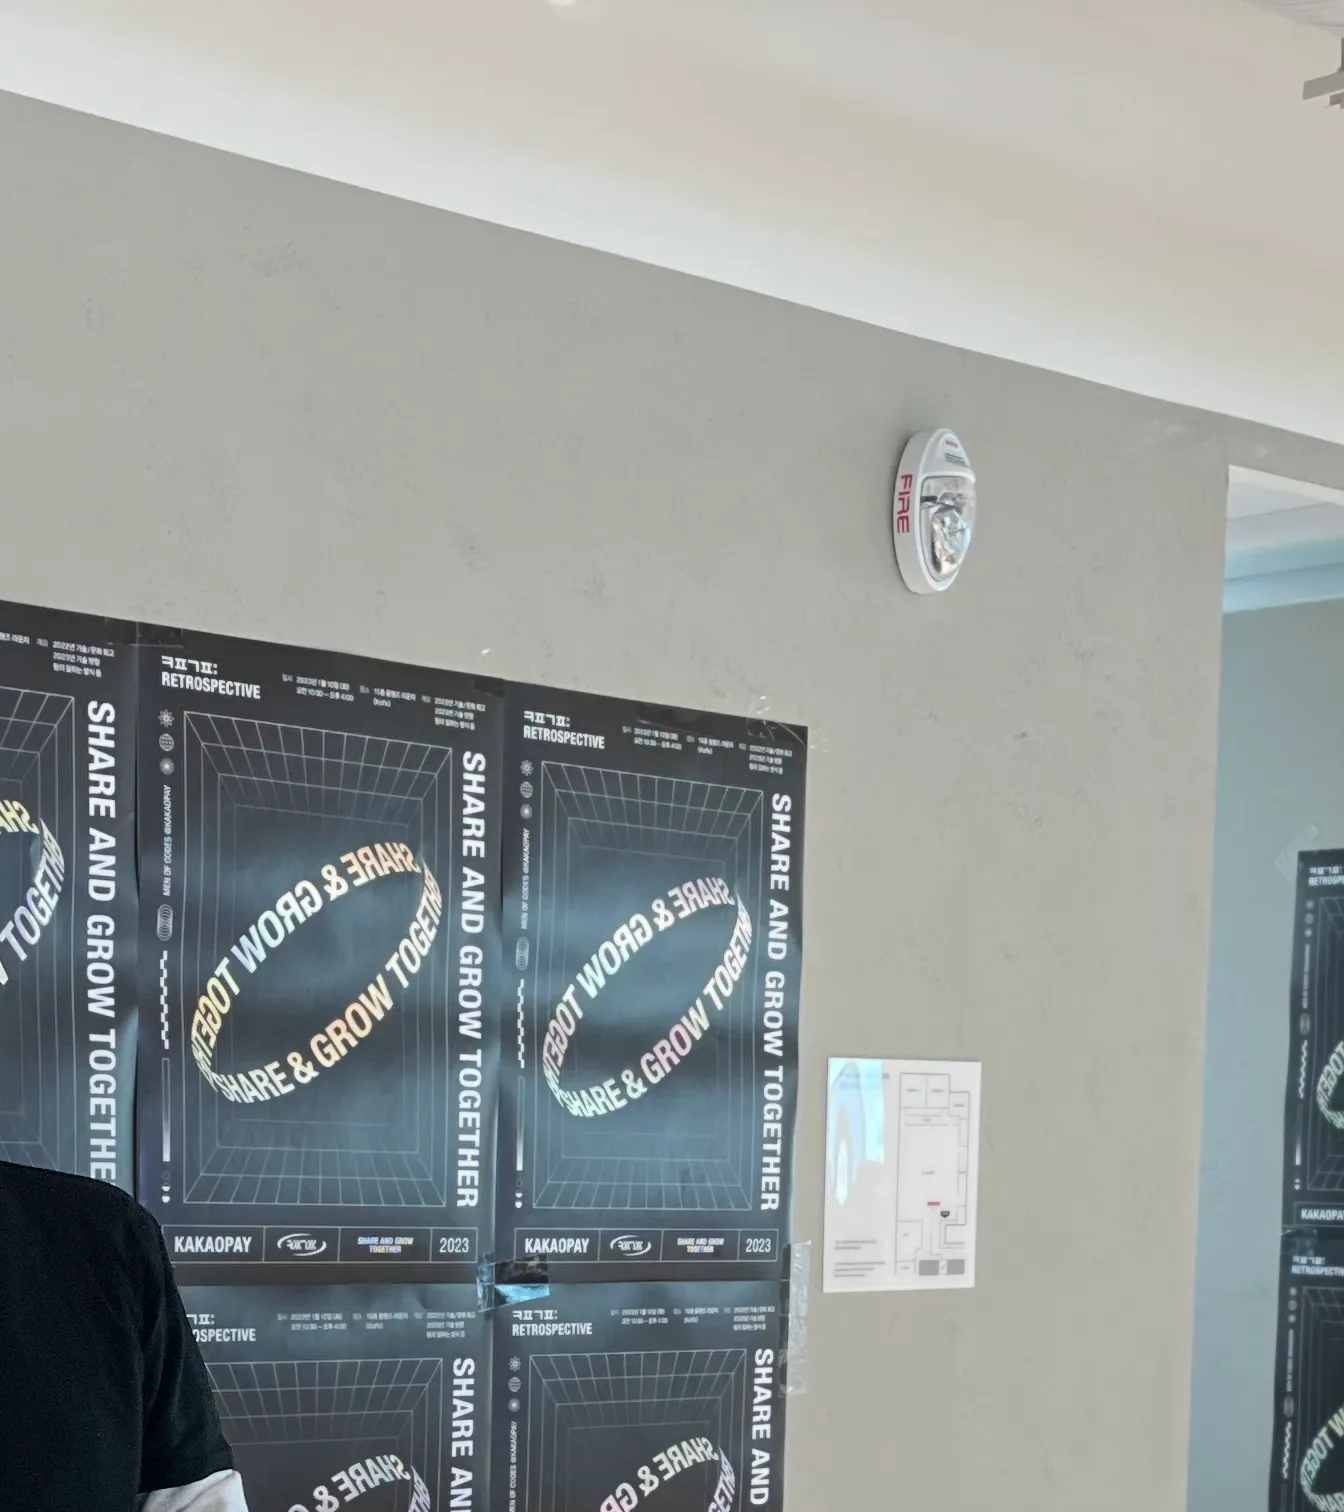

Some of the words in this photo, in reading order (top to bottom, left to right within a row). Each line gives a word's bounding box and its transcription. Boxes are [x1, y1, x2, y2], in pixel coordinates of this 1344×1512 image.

[897, 474, 913, 534] FIRE
[162, 670, 260, 699] RETROSPECTIVE
[87, 700, 116, 818] SHARE
[524, 724, 604, 749] RETROSPECTIVE
[462, 750, 485, 858] SHARE
[770, 793, 791, 891] SHARE
[88, 827, 116, 902] AND
[461, 866, 485, 934] AND
[87, 913, 114, 1017] GROW
[767, 899, 788, 961] AND
[458, 944, 482, 1038] GROW
[763, 970, 784, 1056] GROW
[211, 1061, 295, 1102] SHARE
[287, 1052, 319, 1083] &
[310, 974, 393, 1067] GROW
[640, 997, 709, 1083] GROW
[89, 1027, 116, 1184] TOGETHE
[457, 1047, 481, 1207] TOGETHER
[760, 1064, 783, 1210] TOGETHER
[174, 1236, 251, 1253] KAKAOPAY
[439, 1237, 470, 1253] 2023
[525, 1238, 588, 1253] KAKAOPAY
[745, 1238, 771, 1252] 2023
[513, 1322, 592, 1336] RETROSPECTIVE
[451, 1358, 474, 1456] SHARE
[752, 1348, 772, 1439] SHARE
[749, 1447, 770, 1505] AND
